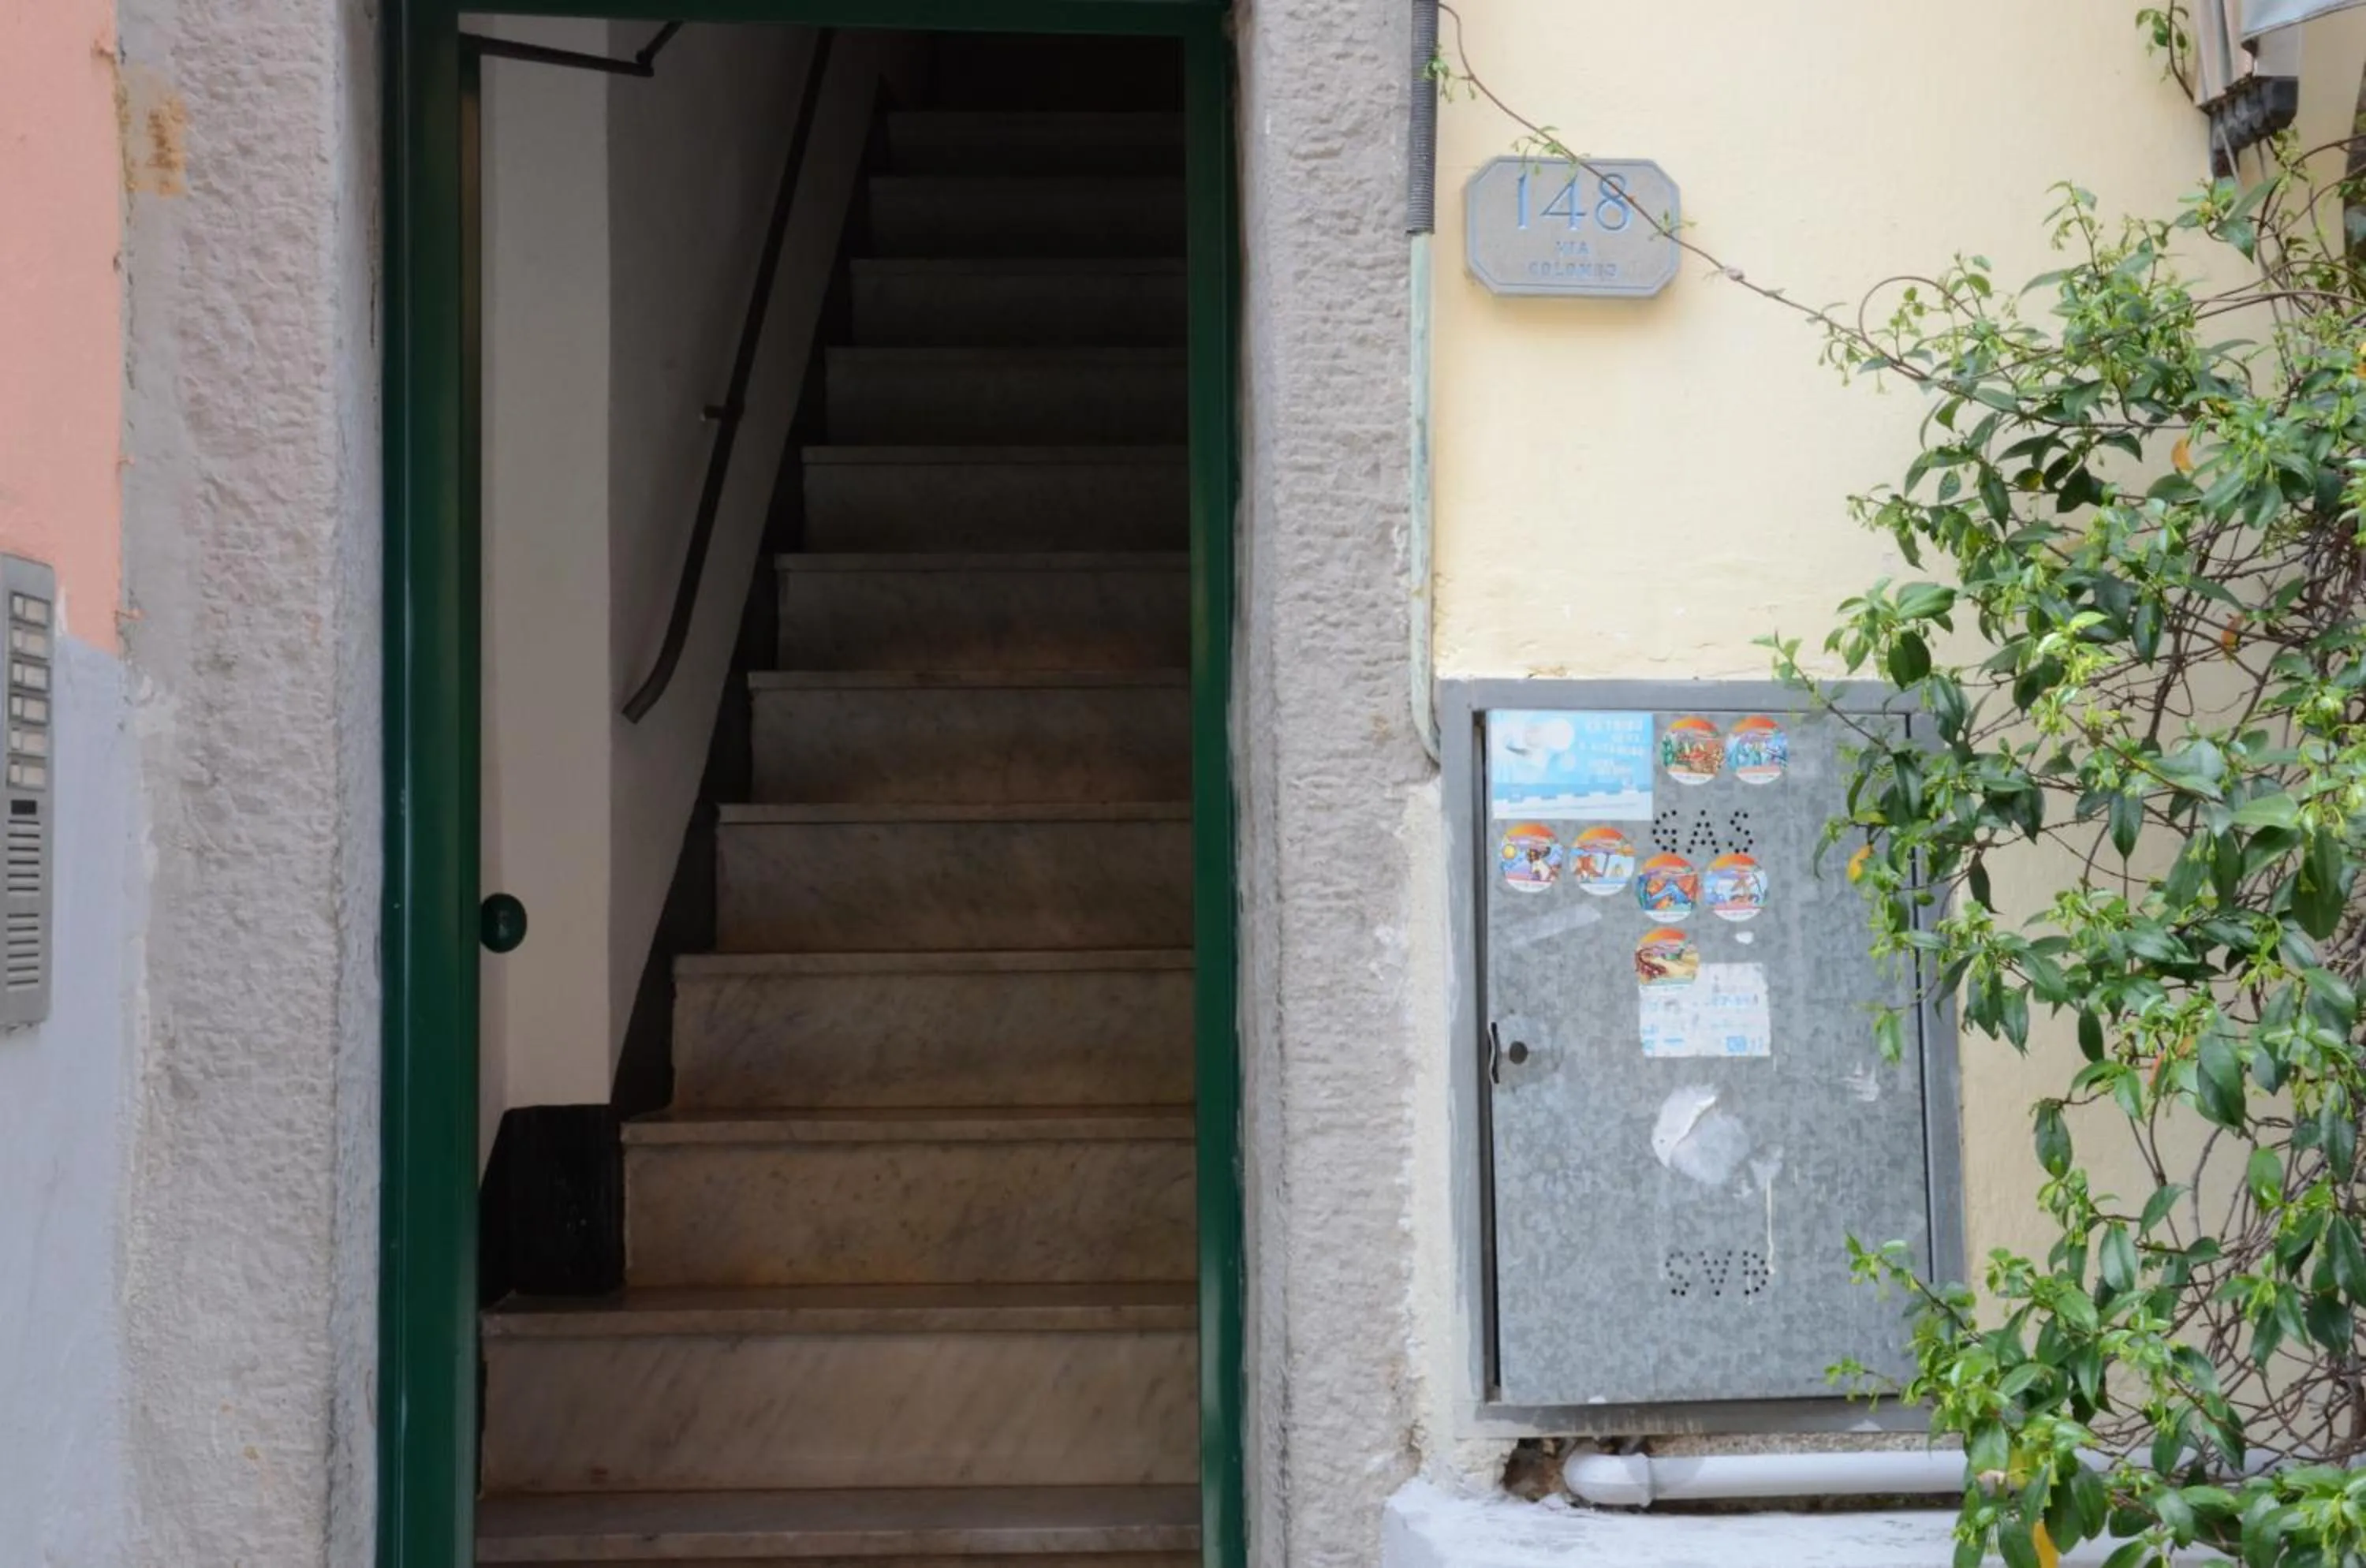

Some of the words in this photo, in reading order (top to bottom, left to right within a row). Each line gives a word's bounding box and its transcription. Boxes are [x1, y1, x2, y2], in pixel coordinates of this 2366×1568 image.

[1517, 172, 1633, 231] 148
[1554, 239, 1589, 256] VIA
[1651, 809, 1754, 853] GAS
